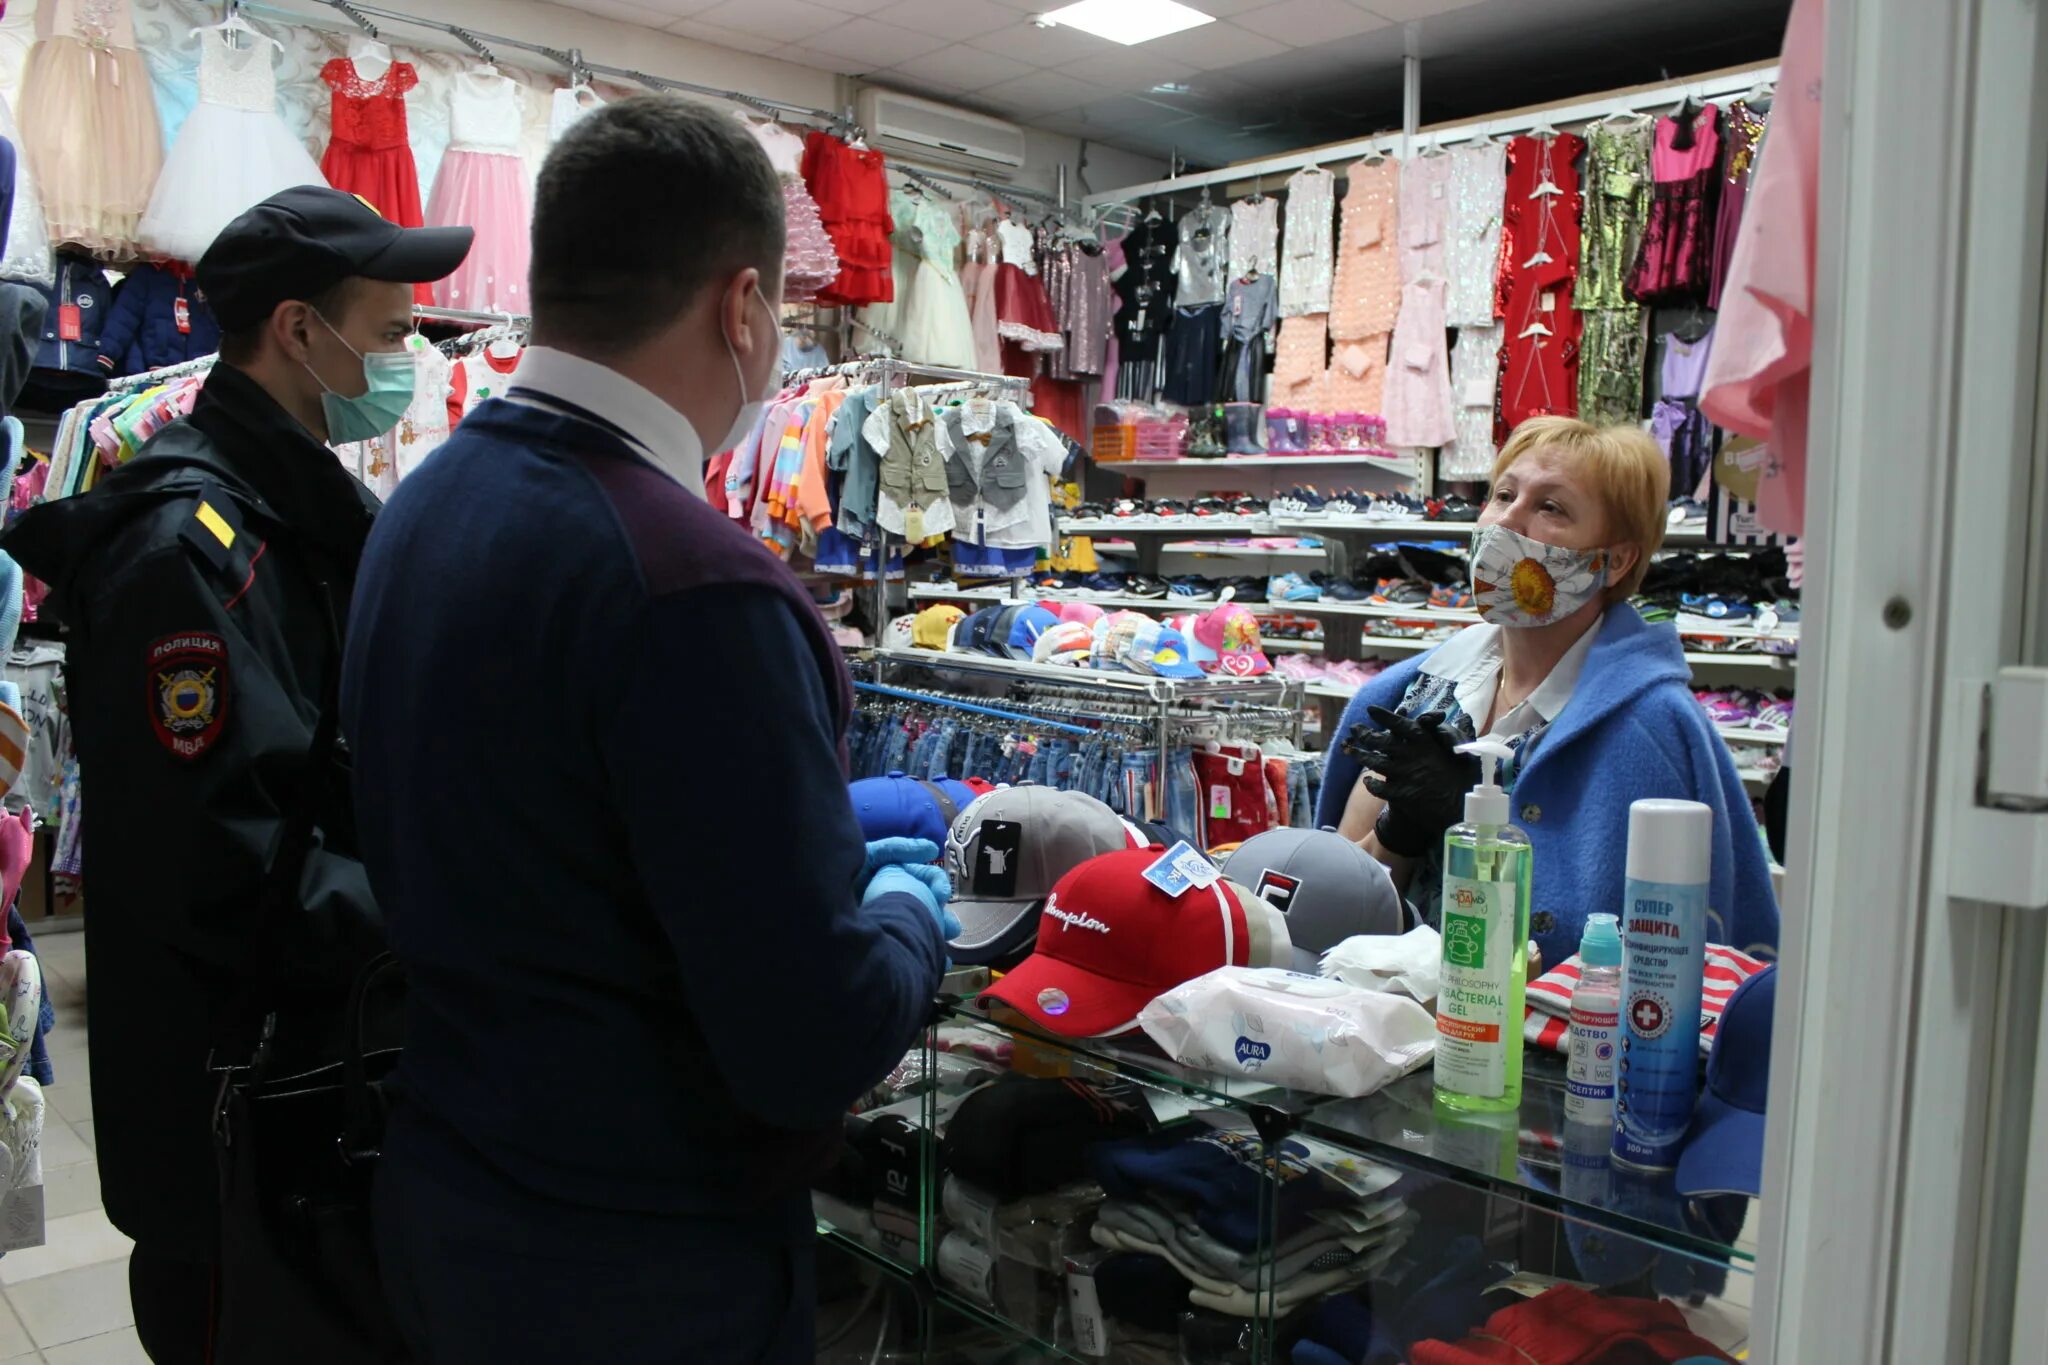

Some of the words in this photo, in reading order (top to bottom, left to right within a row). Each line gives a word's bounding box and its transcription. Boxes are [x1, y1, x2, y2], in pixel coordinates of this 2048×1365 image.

[153, 637, 220, 657] ПОЛИЦИЯ
[173, 736, 204, 755] МВД
[1634, 899, 1674, 916] СУПЕР
[1628, 919, 1680, 939] ЗАЩИТА
[1633, 954, 1669, 968] СРЕДСТВО
[1448, 975, 1499, 990] PHILOSOPHY
[1448, 1002, 1468, 1016] GEL
[1237, 1042, 1266, 1058] AURA
[1596, 1070, 1611, 1078] WC
